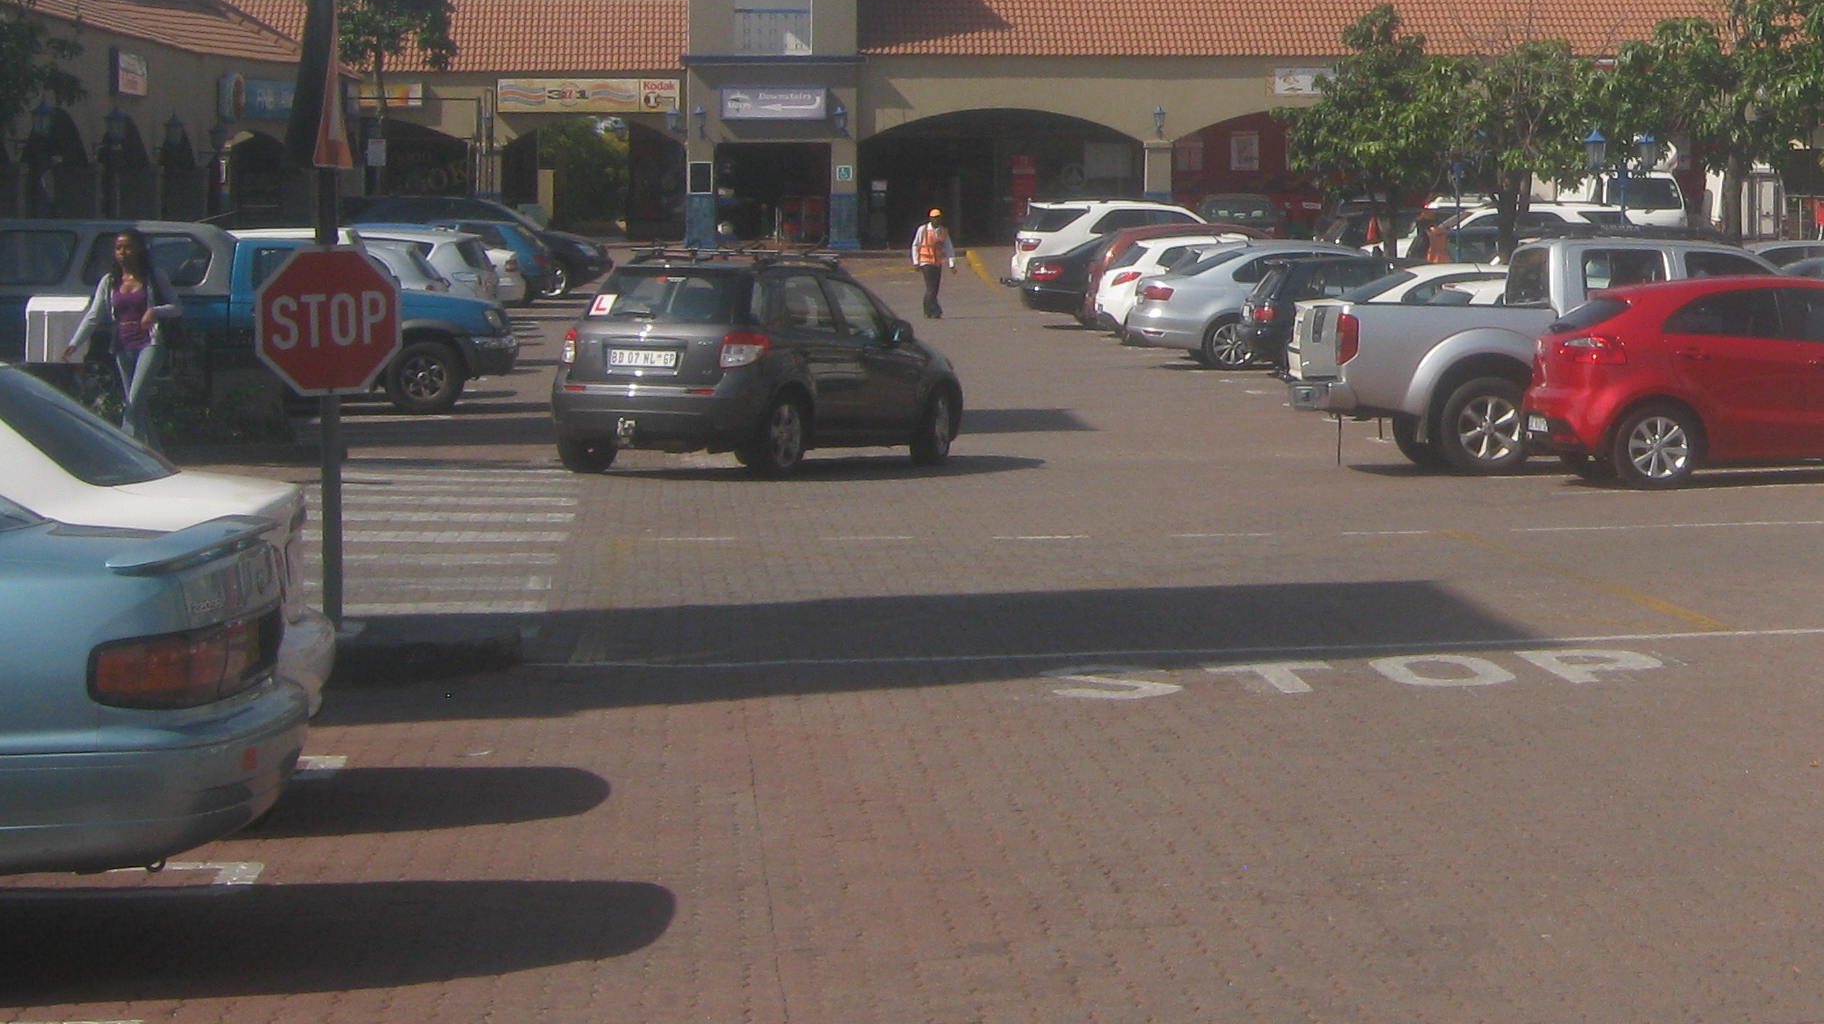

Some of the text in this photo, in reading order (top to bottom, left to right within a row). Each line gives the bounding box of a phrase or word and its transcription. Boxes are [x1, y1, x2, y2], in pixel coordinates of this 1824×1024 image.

[643, 80, 675, 91] Kodak
[271, 290, 387, 351] STOP
[594, 296, 607, 312] L
[1052, 649, 1666, 700] STOP
